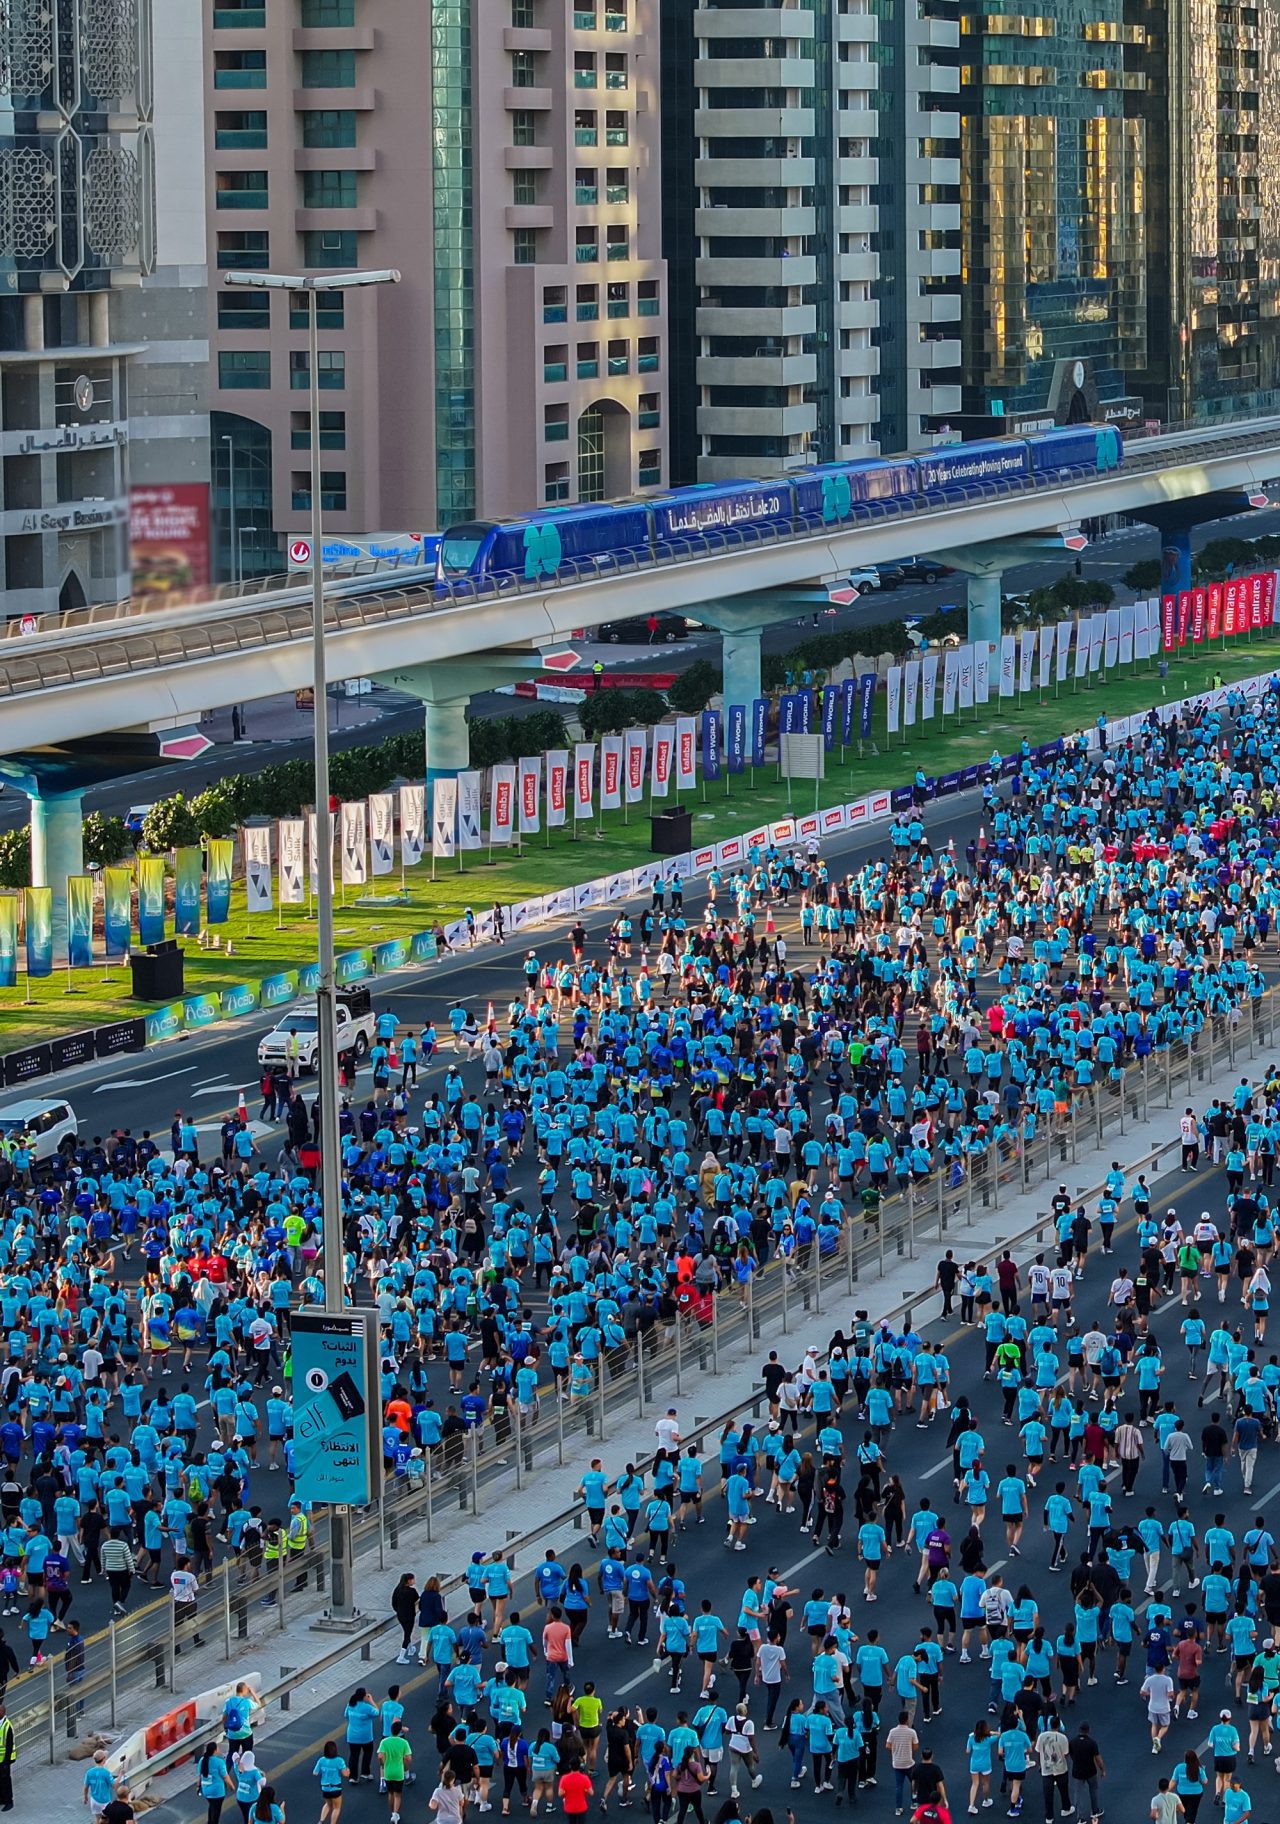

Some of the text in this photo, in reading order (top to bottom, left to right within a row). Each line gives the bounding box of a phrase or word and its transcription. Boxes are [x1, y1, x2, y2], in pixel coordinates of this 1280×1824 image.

[1001, 454, 1023, 470] Forward
[769, 497, 780, 514] 20
[22, 515, 37, 532] Al
[1225, 586, 1236, 632] Emirates
[1252, 579, 1260, 624] Emirates
[1165, 601, 1173, 648] Emirates
[1003, 656, 1012, 679] AWR
[962, 665, 970, 688] AWR
[864, 679, 872, 710] WORLD
[827, 722, 832, 734] DP
[683, 736, 692, 772] talabat
[710, 746, 716, 761] DP
[735, 740, 740, 755] DP
[632, 749, 641, 786] talabat
[658, 743, 668, 782] talabat
[580, 763, 590, 801] talabat
[607, 756, 617, 794] talabat
[526, 777, 535, 815] talabat
[553, 770, 563, 808] talabat
[498, 786, 509, 824] talabat
[390, 948, 406, 962] CBD
[351, 959, 368, 972] CBD
[276, 982, 293, 994] CBD
[238, 994, 254, 1007] CBD
[196, 1005, 214, 1020] CBD
[161, 1015, 178, 1031] CBD
[1034, 1272, 1043, 1283] 10
[1056, 1277, 1065, 1288] 10
[322, 1341, 356, 1354] الثبات؟
[336, 1358, 356, 1368] يدوم
[300, 1402, 326, 1438] elf
[321, 1441, 359, 1453] الانتظار؟
[387, 1438, 394, 1448] 9
[333, 1456, 360, 1467] انتهى
[397, 1453, 406, 1463] 10
